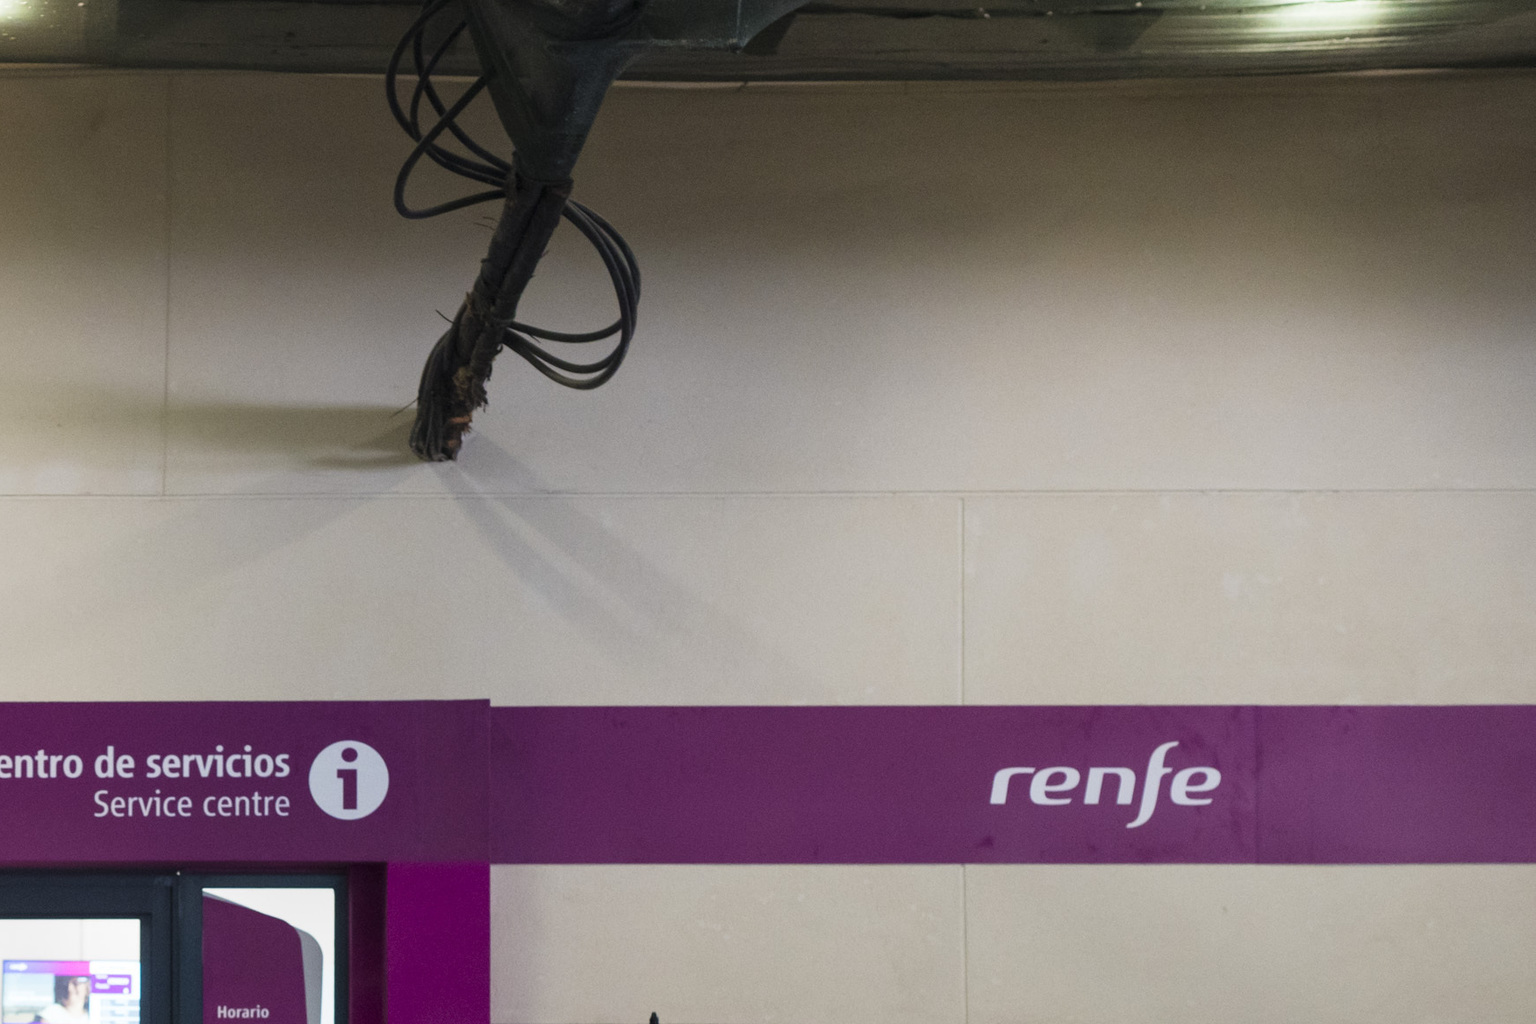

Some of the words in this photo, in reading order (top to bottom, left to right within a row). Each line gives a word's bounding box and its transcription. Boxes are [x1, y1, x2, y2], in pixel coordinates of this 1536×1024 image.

[94, 745, 135, 779] de
[146, 744, 290, 779] servicios
[989, 741, 1222, 829] renfe
[93, 789, 193, 818] Service
[203, 791, 290, 817] centre
[217, 1004, 270, 1019] Horario
